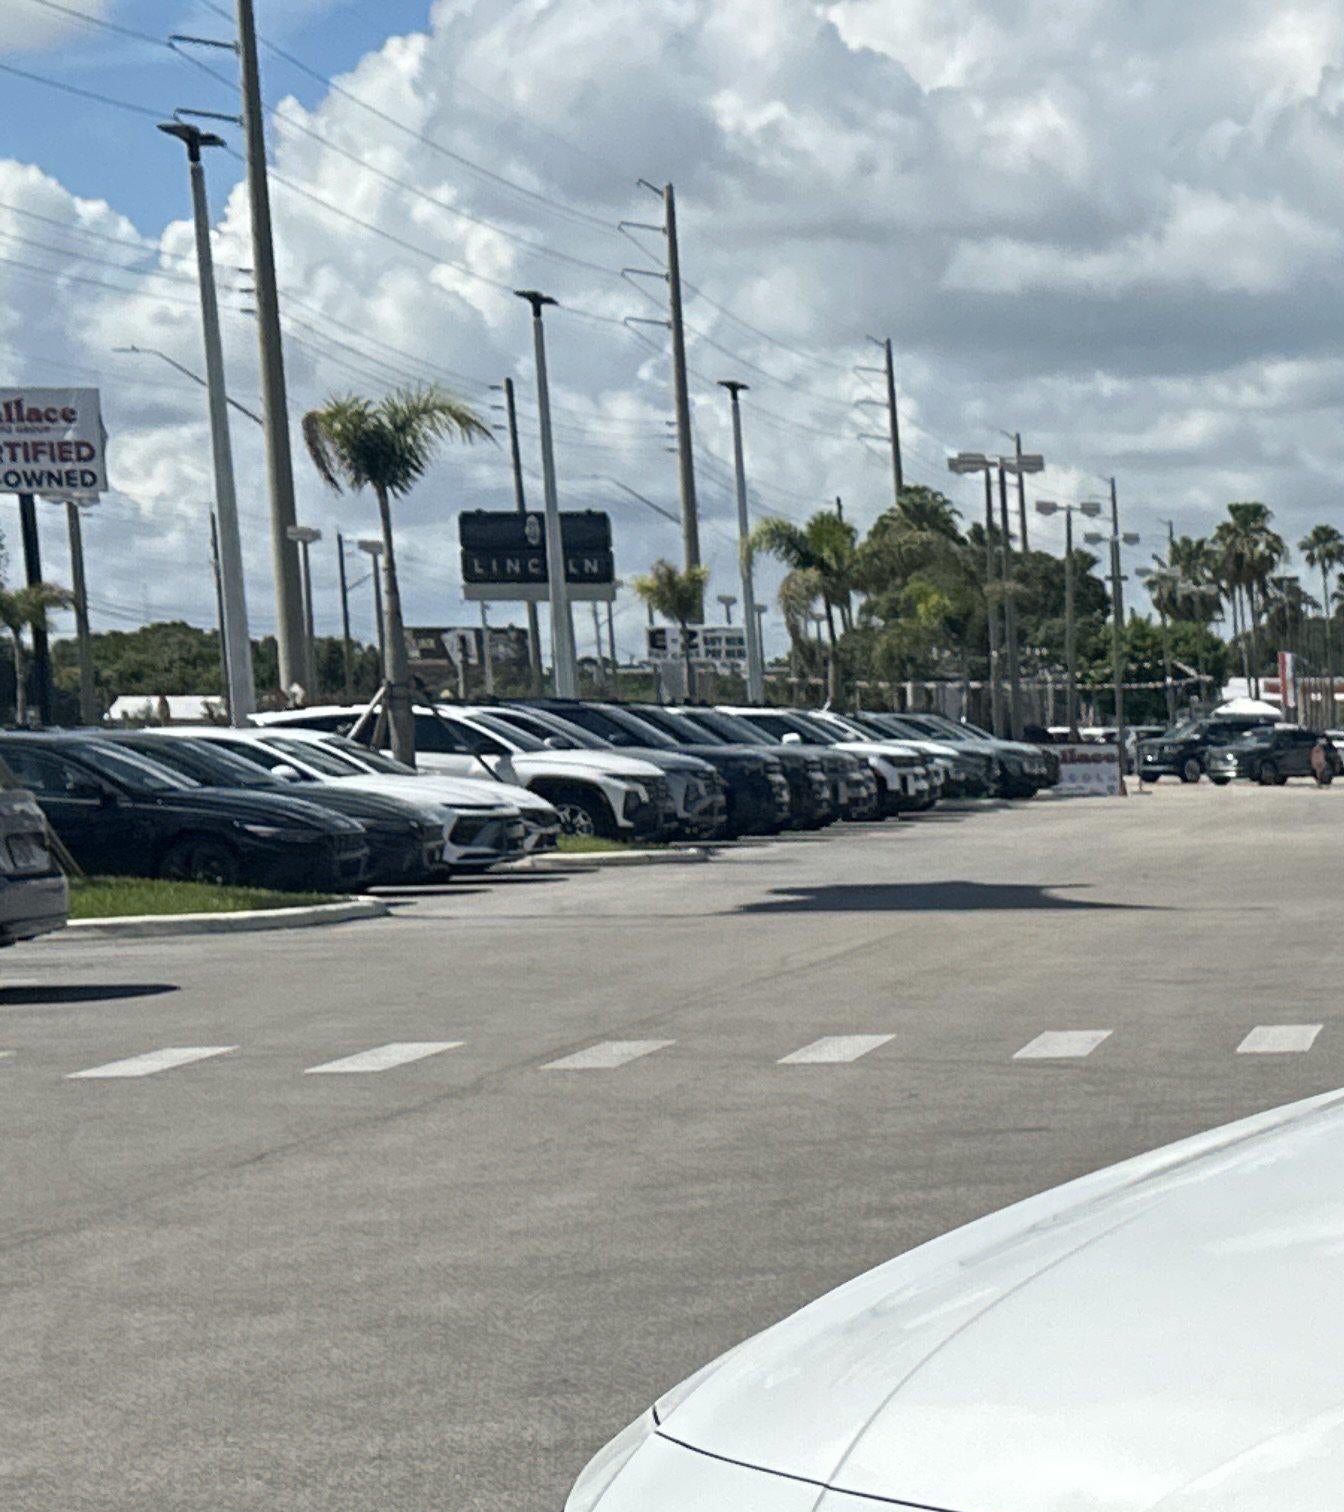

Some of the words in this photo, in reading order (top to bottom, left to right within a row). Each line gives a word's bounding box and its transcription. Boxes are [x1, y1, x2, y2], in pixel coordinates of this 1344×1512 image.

[0, 398, 78, 423] llace
[0, 441, 95, 463] TIFIED
[473, 557, 599, 575] LINCLN
